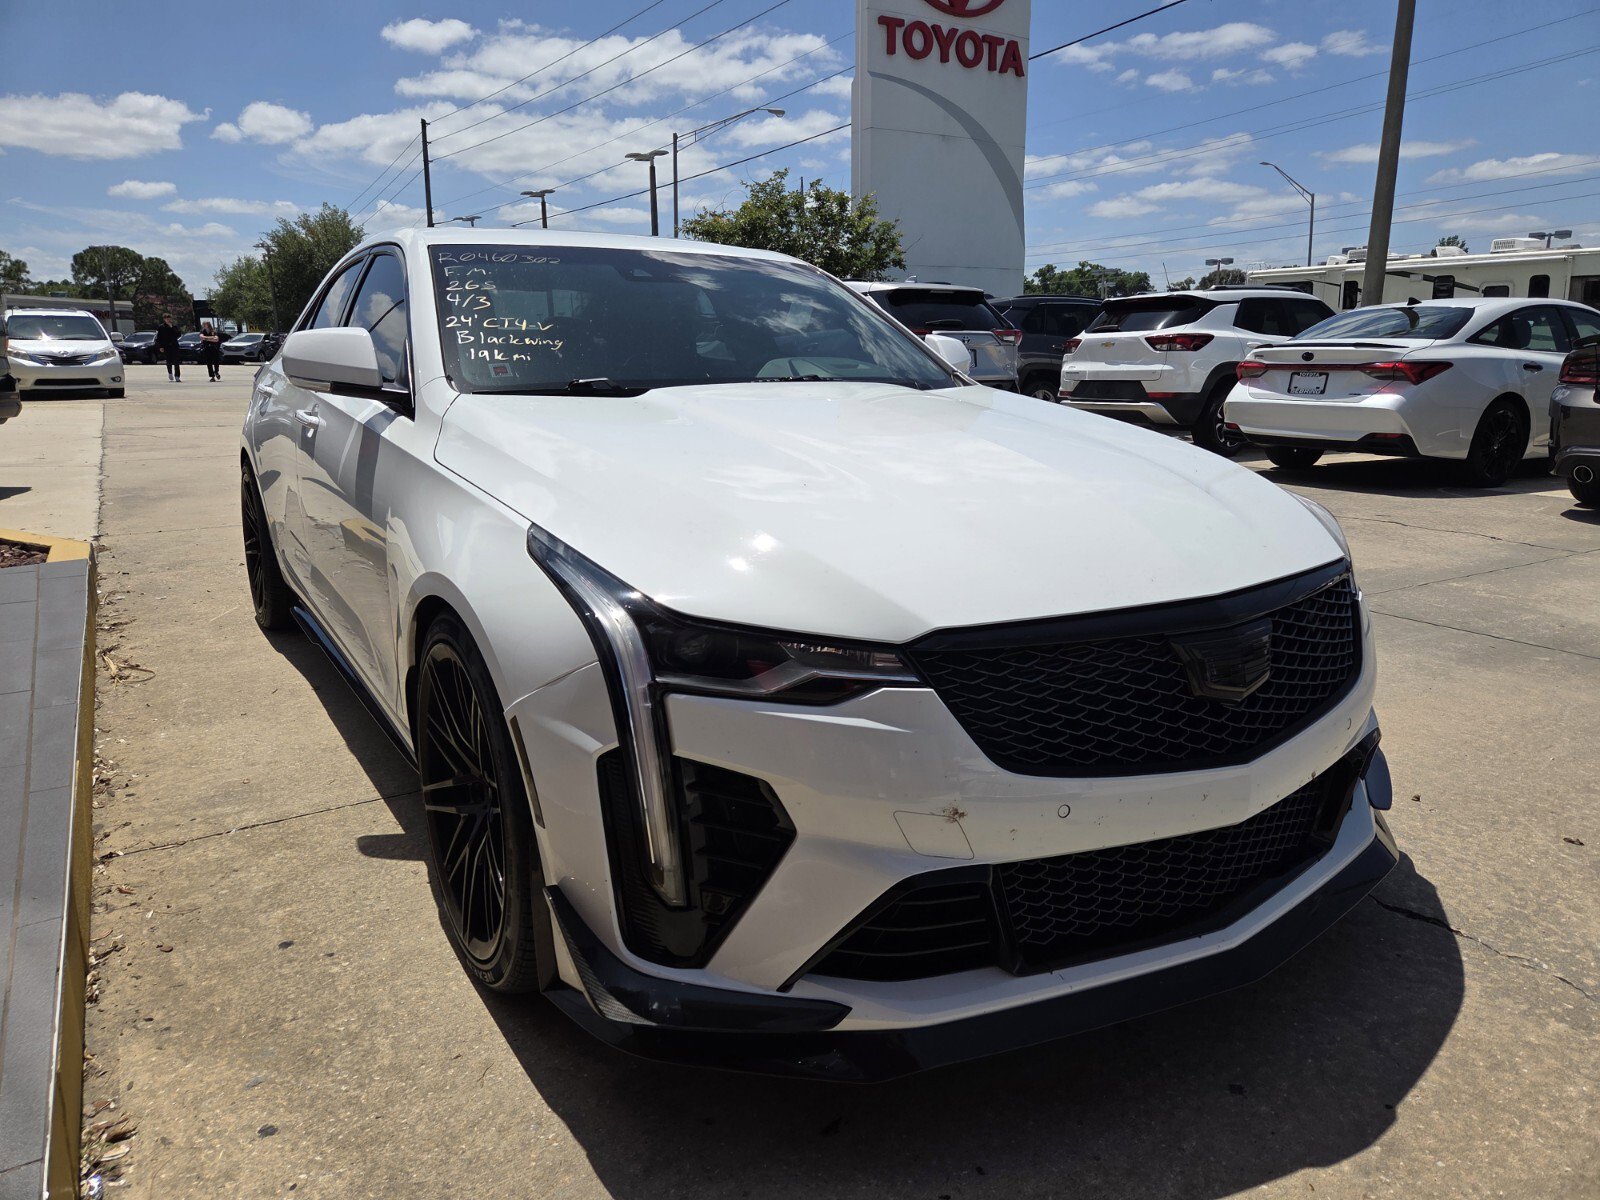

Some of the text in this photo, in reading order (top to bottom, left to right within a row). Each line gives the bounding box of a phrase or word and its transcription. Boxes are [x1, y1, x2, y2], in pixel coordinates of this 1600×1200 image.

[878, 15, 1024, 77] TOYOTA
[446, 293, 491, 310] 4/3
[456, 330, 563, 350] Blackwing
